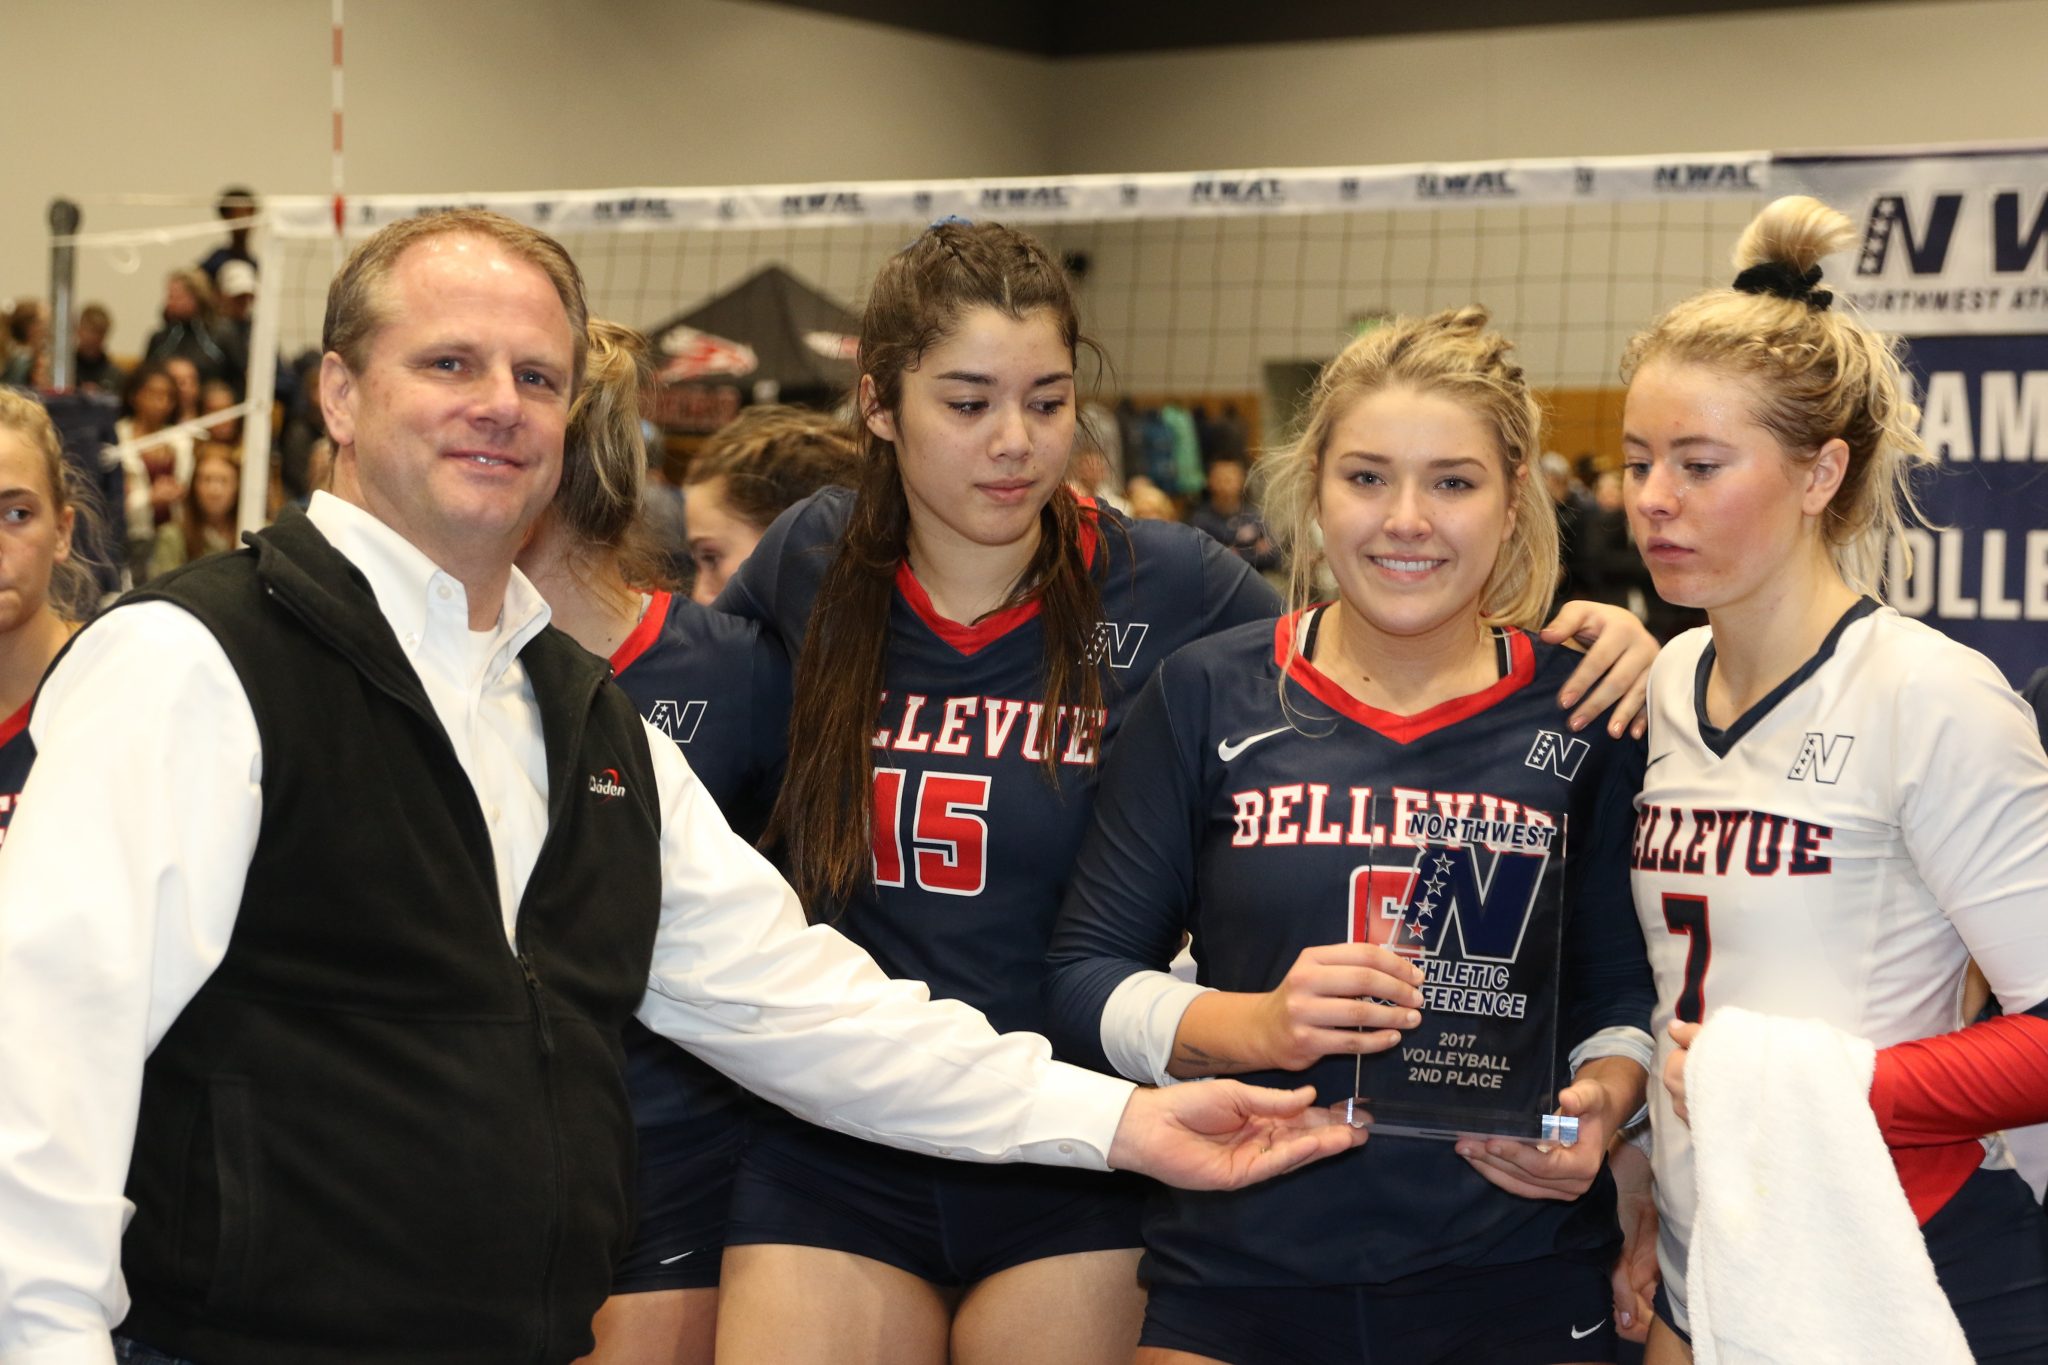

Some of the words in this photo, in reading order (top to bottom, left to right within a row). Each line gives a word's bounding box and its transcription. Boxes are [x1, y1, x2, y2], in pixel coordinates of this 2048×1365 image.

[2011, 285, 2048, 312] AT
[872, 767, 992, 896] 15
[1409, 812, 1557, 850] NORTHWEST
[1408, 957, 1509, 990] THLETIC
[1661, 892, 1711, 1024] 7
[1419, 986, 1527, 1019] FERENCE
[1438, 1032, 1477, 1049] 2017
[1402, 1047, 1511, 1071] VOLLEYBALL
[1408, 1067, 1442, 1083] 2ND
[1445, 1070, 1504, 1089] PLACE
